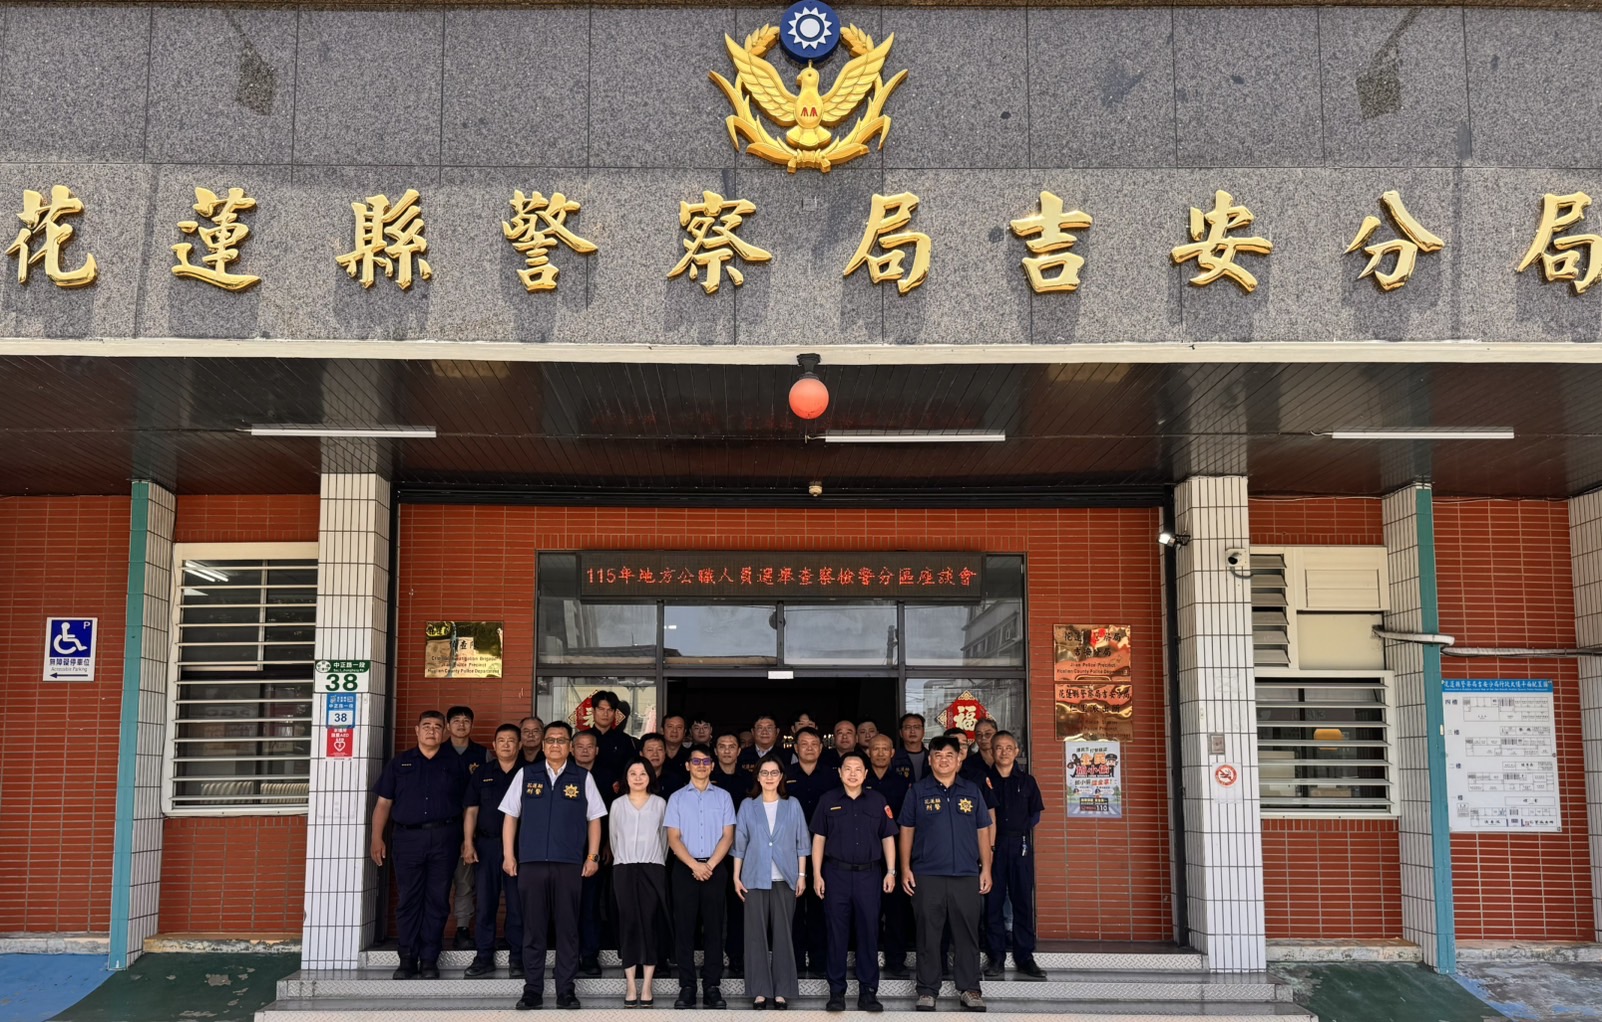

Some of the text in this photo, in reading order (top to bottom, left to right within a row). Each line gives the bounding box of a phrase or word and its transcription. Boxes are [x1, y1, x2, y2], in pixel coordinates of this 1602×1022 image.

[5, 184, 1602, 294] 花蓮縣警察局吉安分局
[586, 566, 977, 586] 115年地方公職人員選舉查察檢警分區座談會
[83, 621, 91, 630] P
[49, 658, 90, 667] 無障礙停車位
[333, 661, 366, 669] 中正路一段
[325, 673, 358, 692] 38
[334, 713, 348, 723] 38
[953, 705, 978, 731] 福
